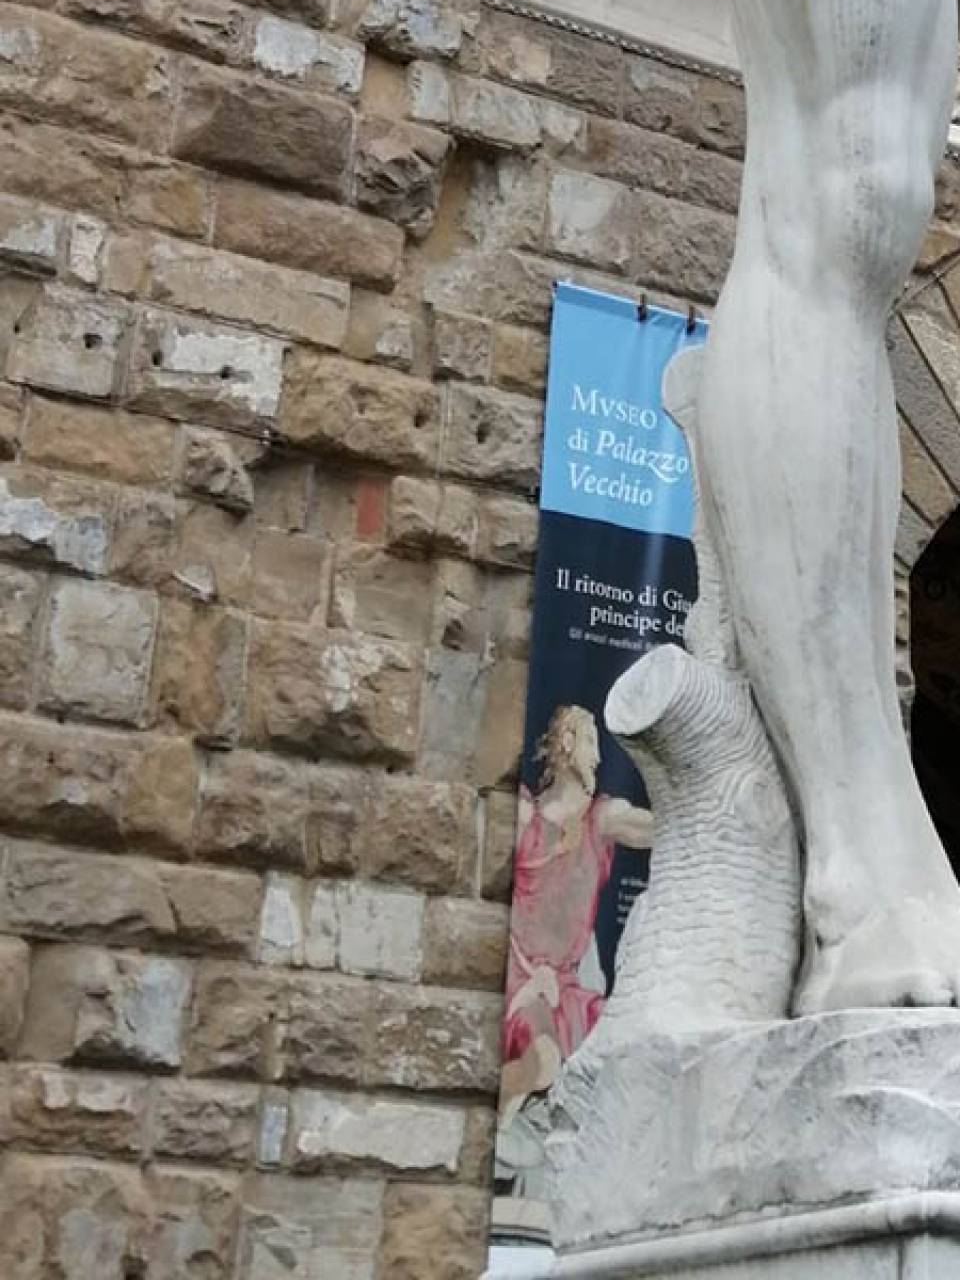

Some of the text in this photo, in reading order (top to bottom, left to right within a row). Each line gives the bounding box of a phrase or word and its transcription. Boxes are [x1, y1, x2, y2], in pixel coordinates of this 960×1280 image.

[568, 426, 689, 483] di Palazzo
[568, 462, 654, 508] Vecchio
[557, 569, 570, 590] Il
[574, 574, 634, 603] ritorno
[637, 585, 657, 606] di
[590, 605, 662, 636] principe
